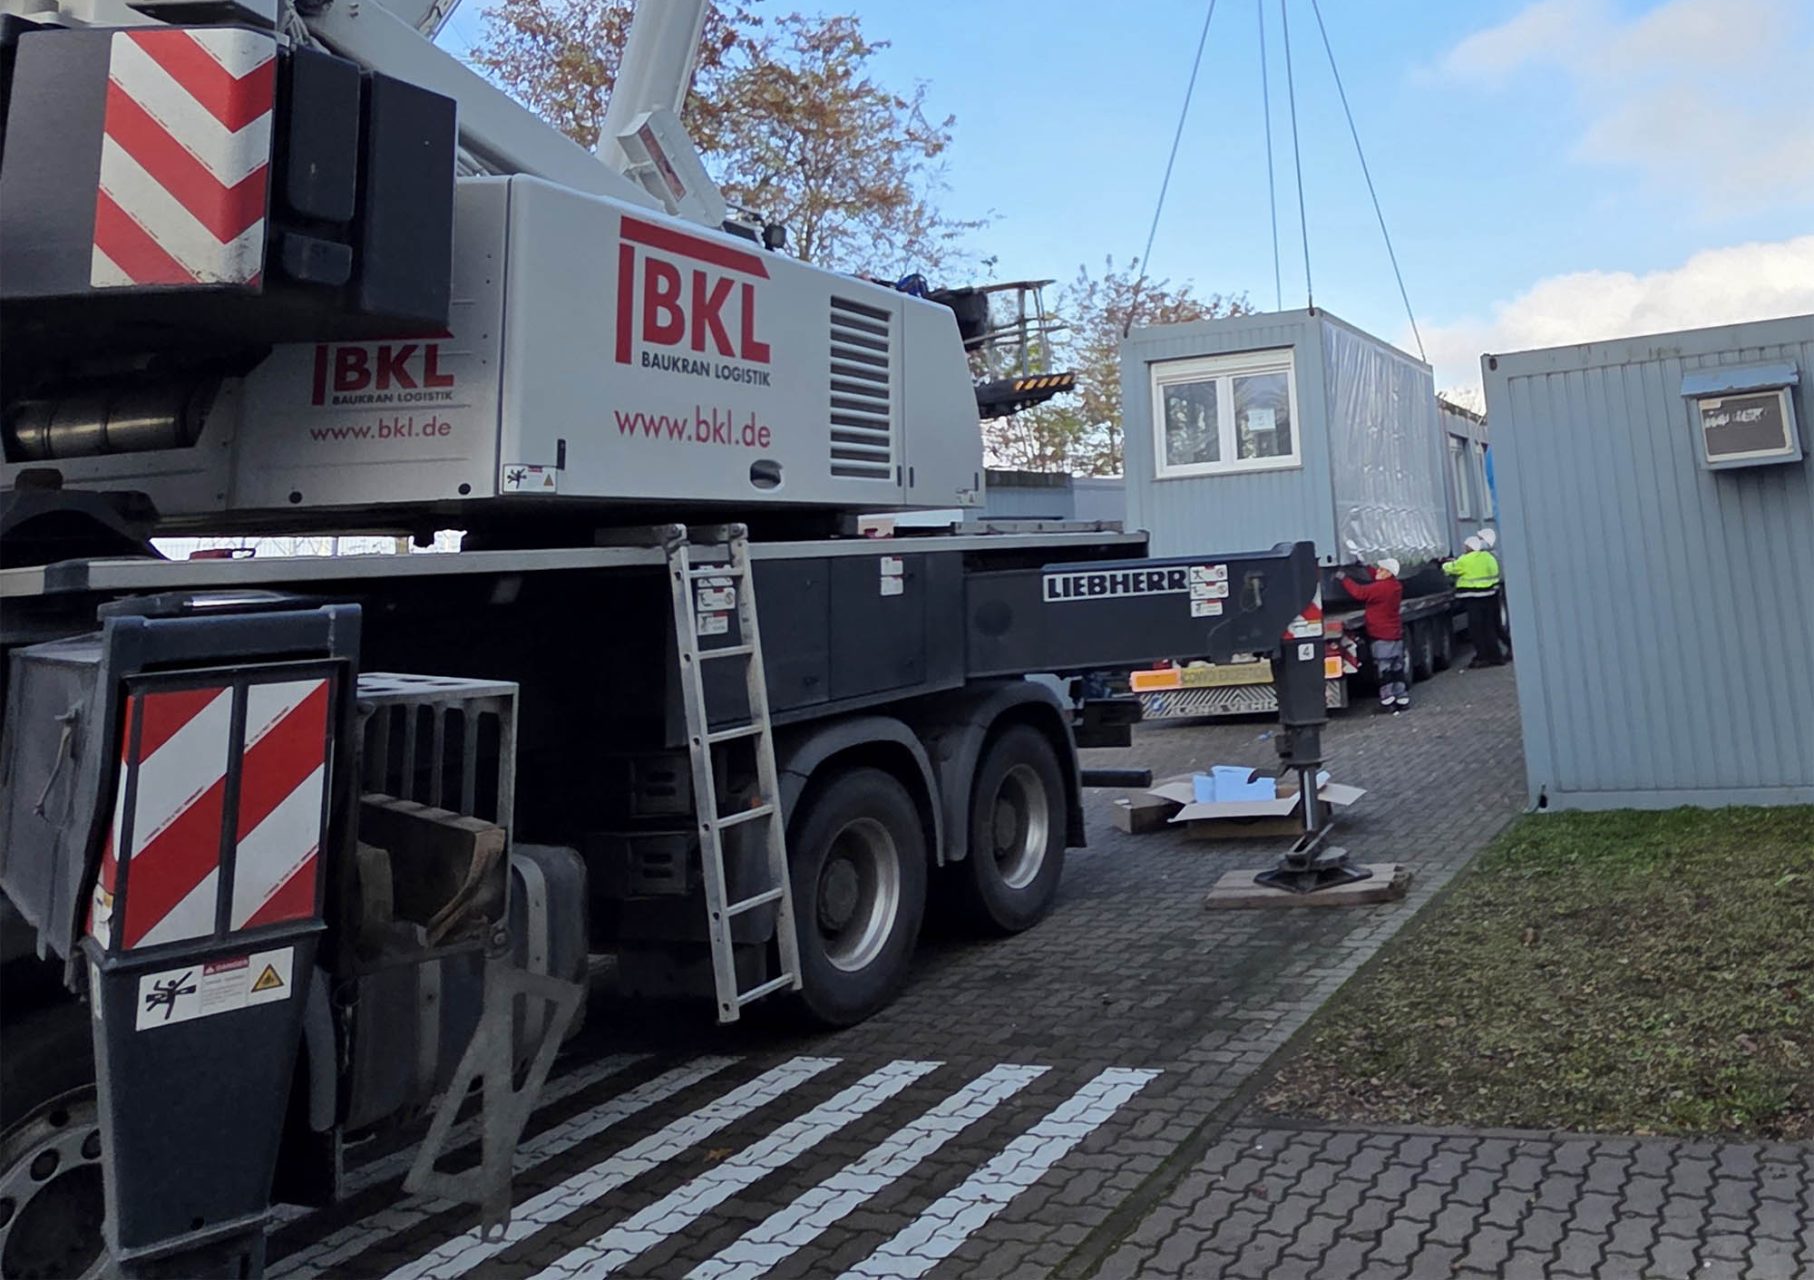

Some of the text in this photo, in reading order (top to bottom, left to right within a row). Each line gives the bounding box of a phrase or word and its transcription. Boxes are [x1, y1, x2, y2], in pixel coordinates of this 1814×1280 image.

[643, 256, 770, 364] BKL
[334, 343, 454, 392] BKL
[641, 351, 771, 386] BAUKRAN LOGISTIK
[332, 390, 453, 405] BAUKRAN LOGISTIK
[310, 416, 452, 441] www.bkl.de
[614, 405, 771, 448] www.bkl.de
[1047, 569, 1187, 599] LIEBHERR
